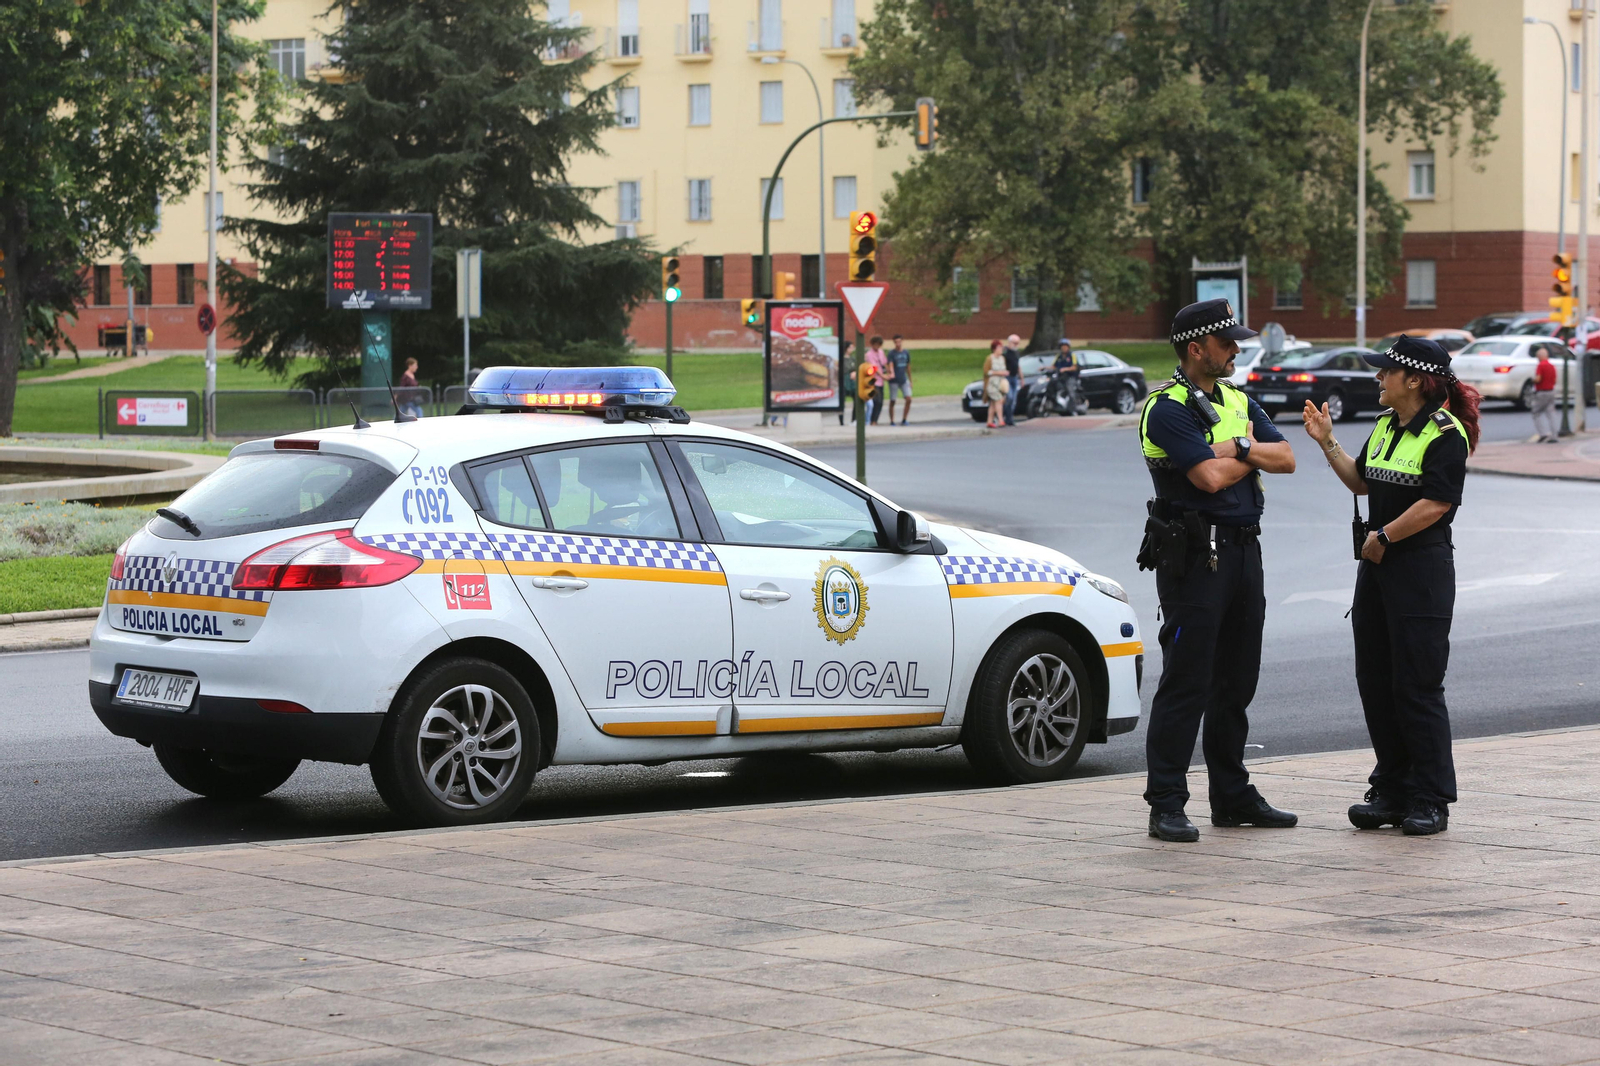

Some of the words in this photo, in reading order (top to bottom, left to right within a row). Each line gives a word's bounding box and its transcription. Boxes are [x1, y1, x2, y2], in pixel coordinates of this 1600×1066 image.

[334, 250, 355, 258] 17:00
[784, 315, 820, 328] nocilla
[410, 465, 449, 486] P-19
[415, 487, 454, 524] 092
[460, 583, 485, 596] 112
[122, 607, 169, 632] POLICIA
[172, 612, 223, 636] LOCAL
[606, 650, 780, 699] POLICÍA
[790, 660, 930, 699] LOCAL
[128, 673, 163, 699] 2004
[163, 677, 194, 702] HVF
